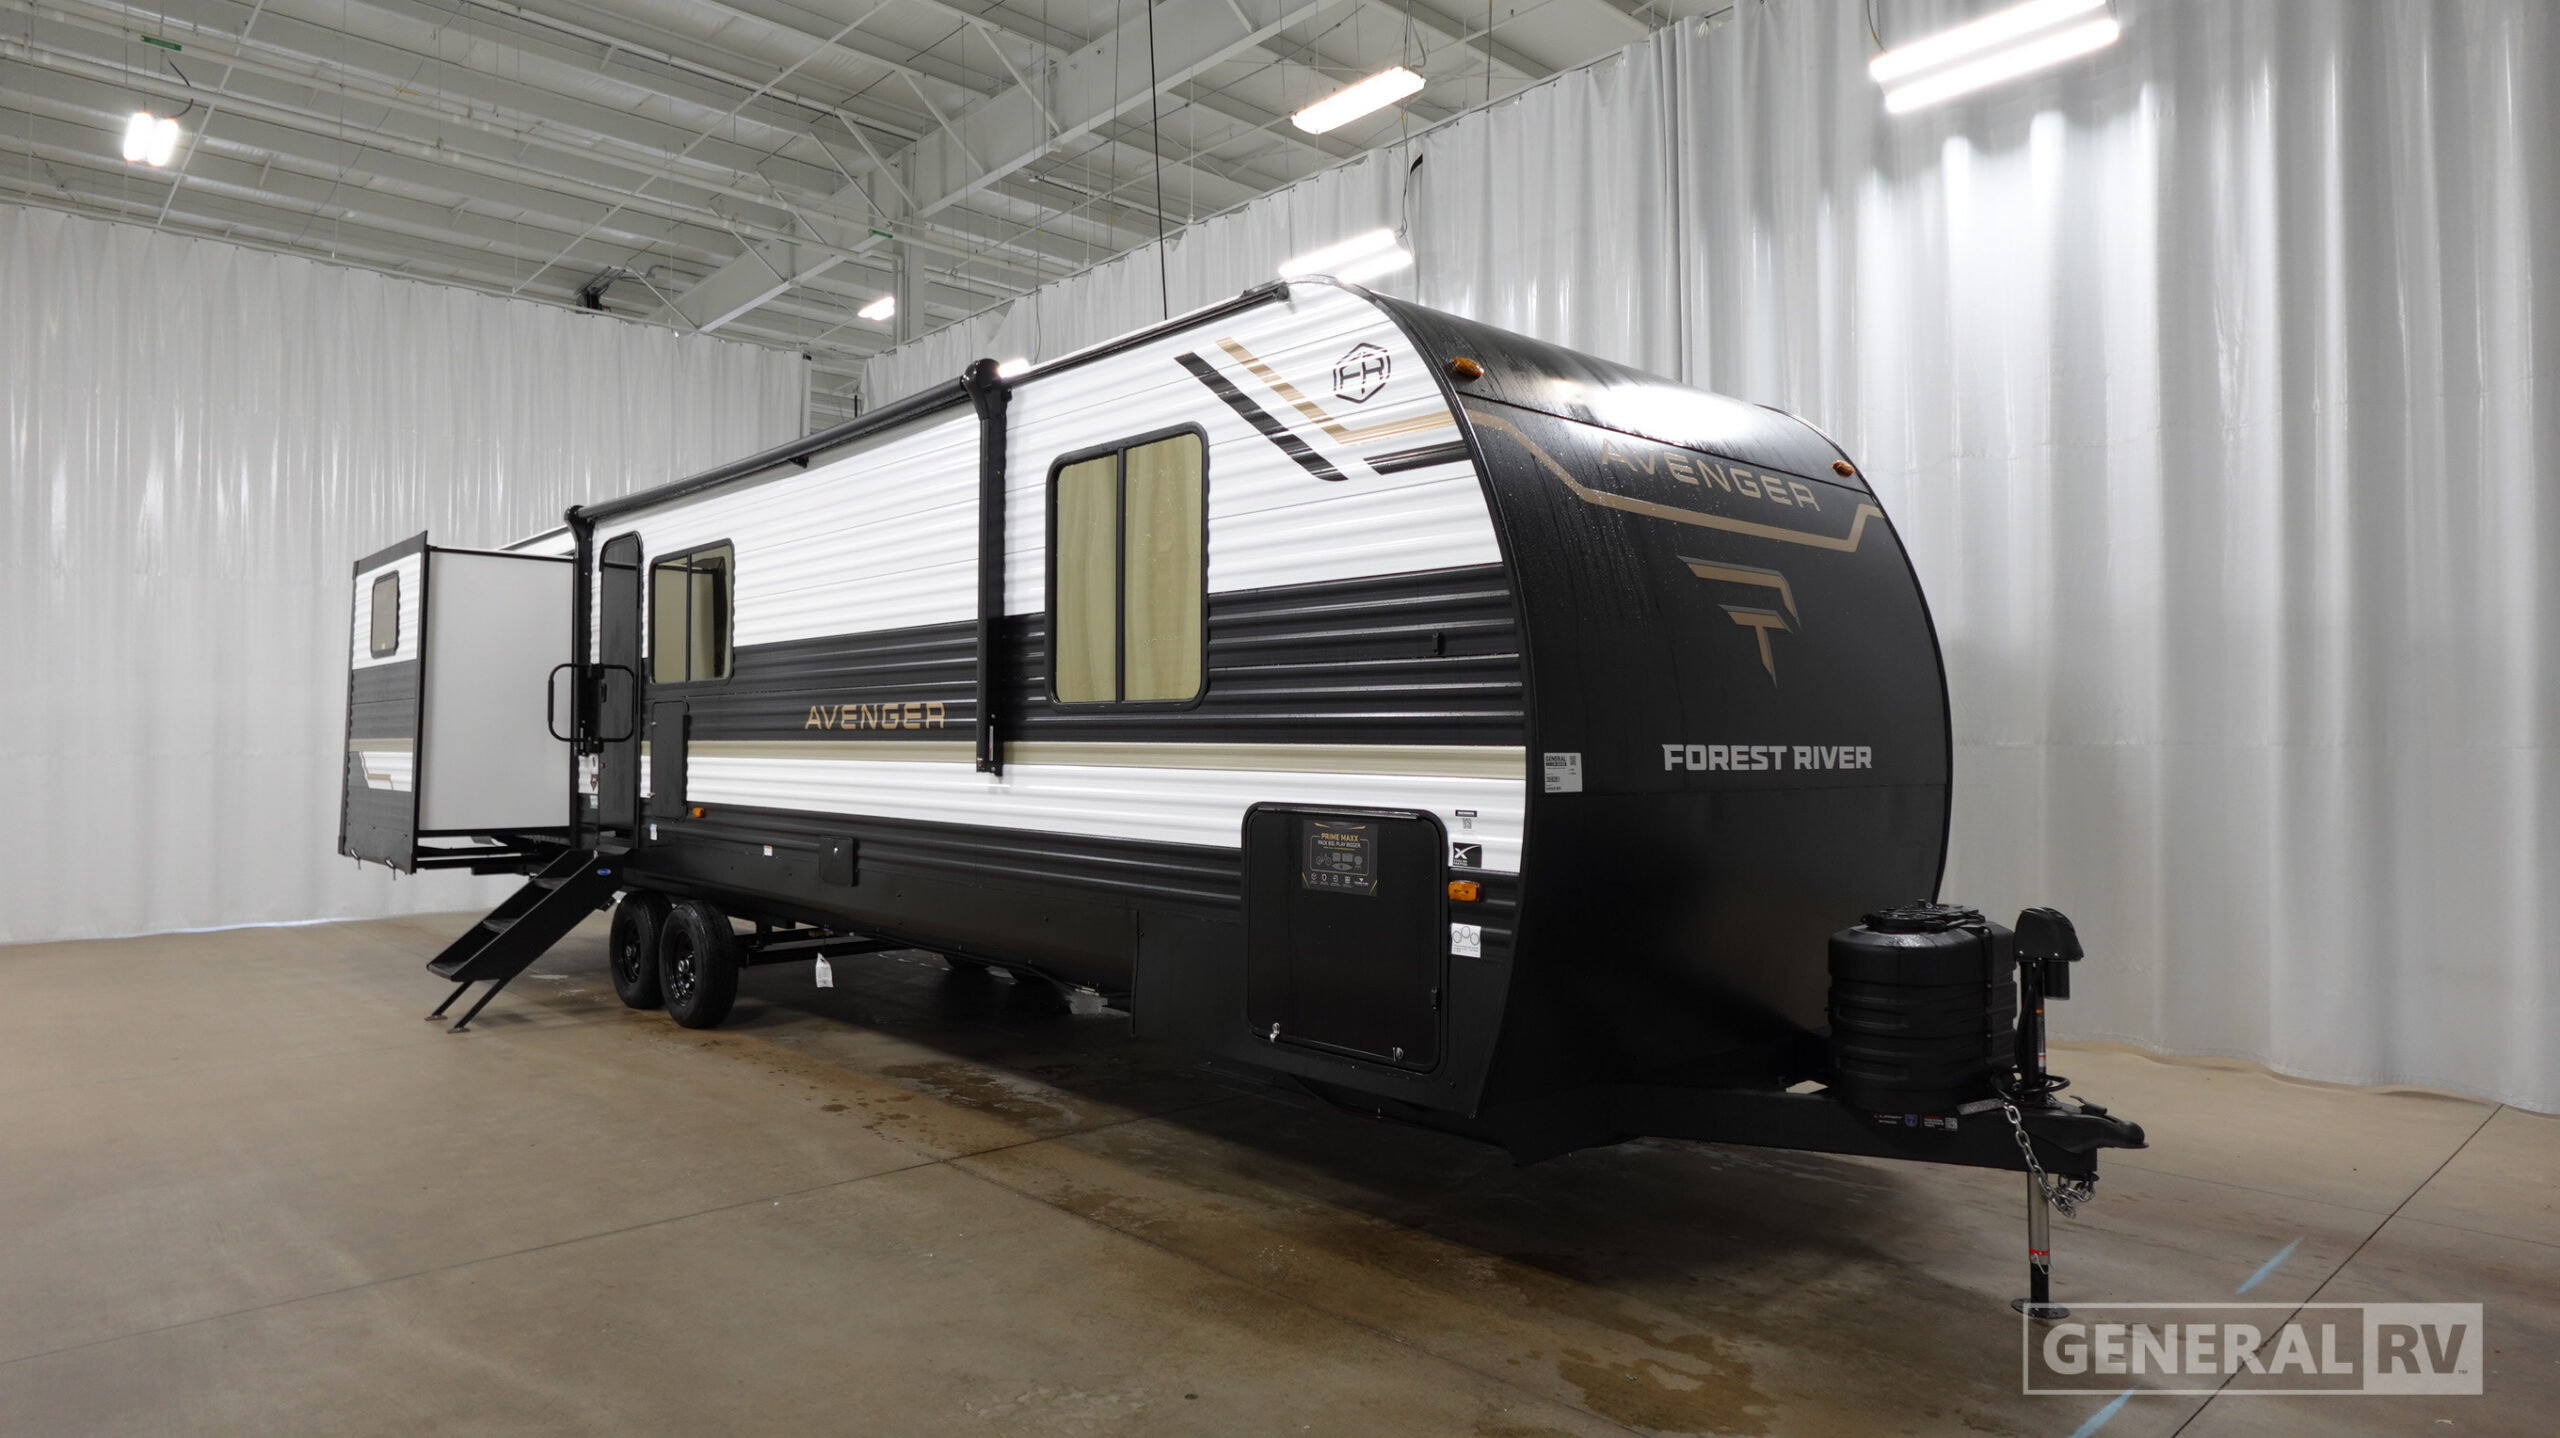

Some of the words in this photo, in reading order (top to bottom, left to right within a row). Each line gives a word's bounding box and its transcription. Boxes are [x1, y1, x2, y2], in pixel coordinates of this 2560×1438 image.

[1601, 438, 1821, 512] AVENGER
[804, 700, 945, 730] AVENGER
[1661, 743, 1788, 771] FOREST
[1792, 745, 1873, 770] RIVER
[1321, 833, 1340, 841] PRIME
